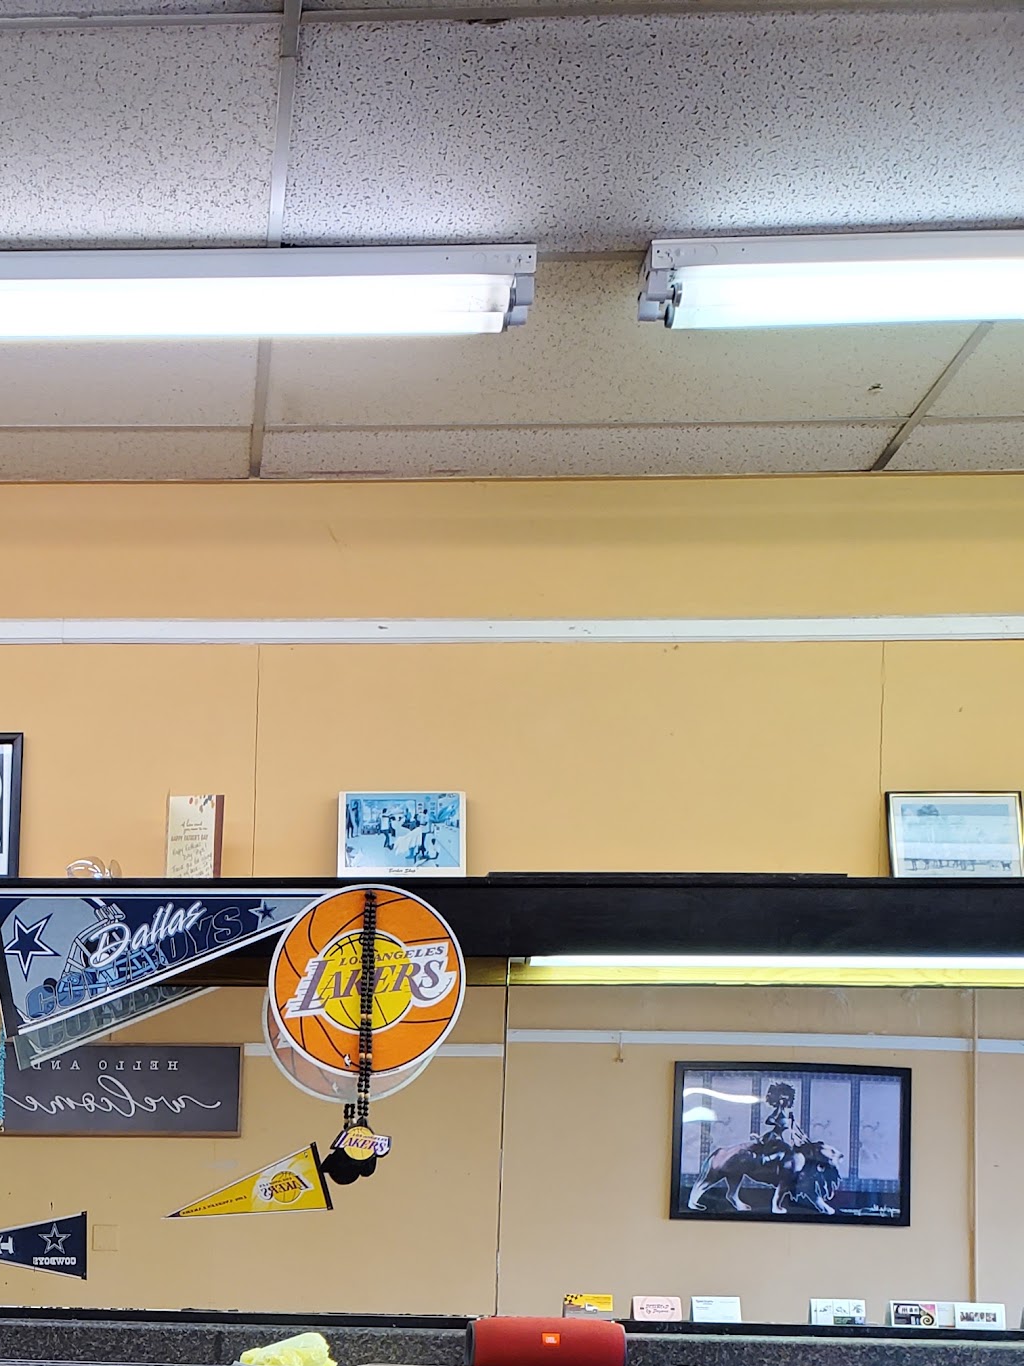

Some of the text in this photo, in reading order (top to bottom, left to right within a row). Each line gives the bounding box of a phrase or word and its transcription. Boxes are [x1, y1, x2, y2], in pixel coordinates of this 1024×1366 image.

[88, 901, 208, 968] Dallas
[374, 945, 445, 962] ANGELES
[291, 959, 452, 1012] LAKERS
[336, 1131, 387, 1153] LAKERS
